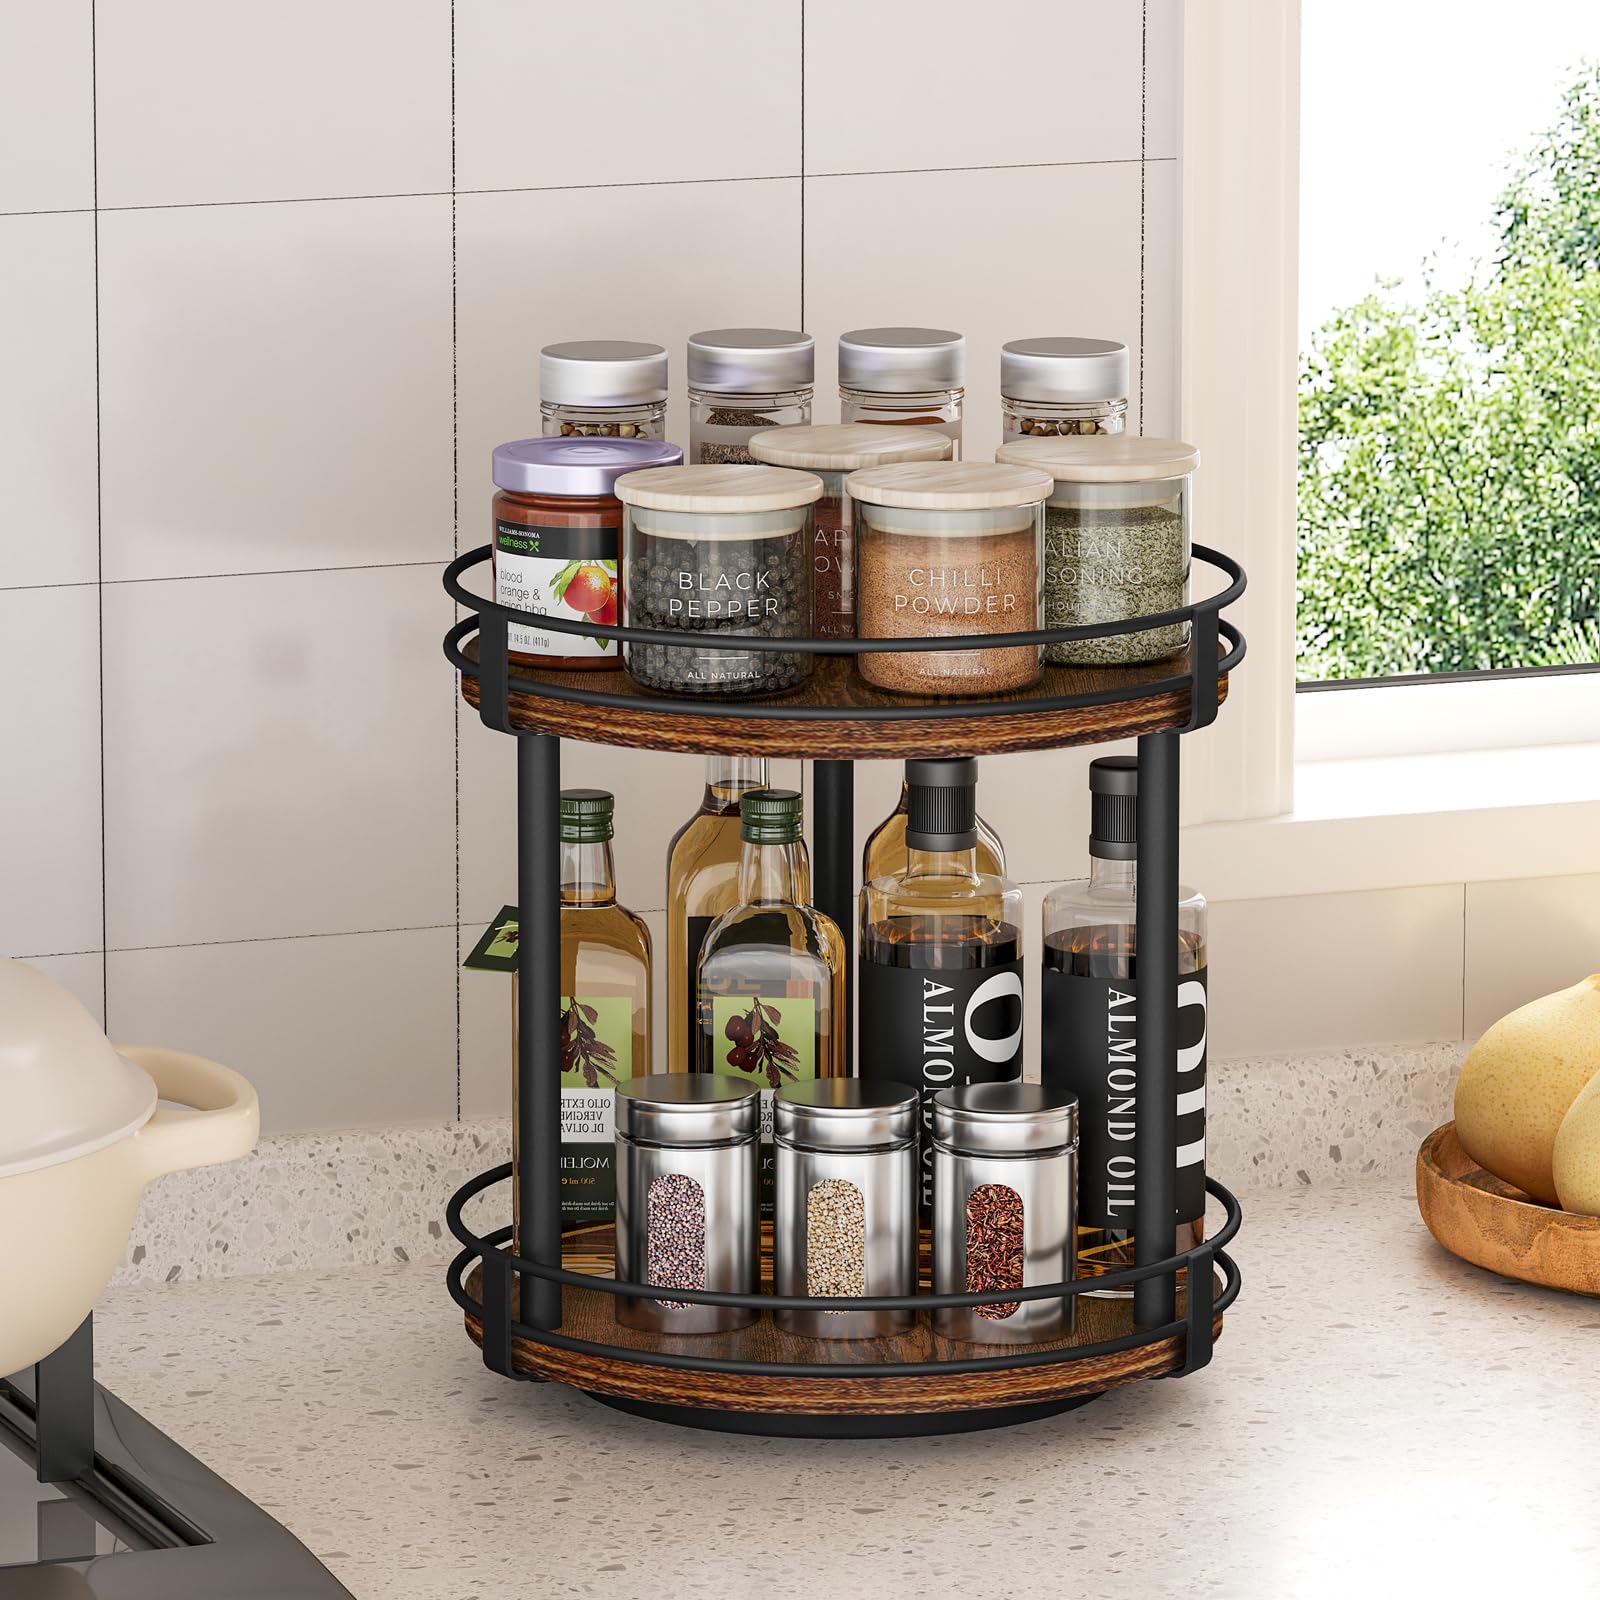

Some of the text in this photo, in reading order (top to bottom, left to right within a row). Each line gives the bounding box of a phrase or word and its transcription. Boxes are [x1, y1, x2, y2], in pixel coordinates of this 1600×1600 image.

[498, 526, 540, 538] WILLIAMS-SONOMA
[499, 536, 528, 550] wellness
[1045, 539, 1121, 558] ALIAN
[500, 568, 523, 583] blood
[679, 571, 770, 591] BLACK
[909, 568, 1000, 587] CHILLI
[1046, 567, 1143, 585] SONING
[500, 585, 541, 601] orange &
[669, 598, 778, 618] PEPPER
[895, 594, 1016, 614] POWDER
[687, 671, 760, 680] ALL NATURAL
[919, 667, 993, 677] ALL NATURAL
[1106, 986, 1137, 1217] ALMOND OIL
